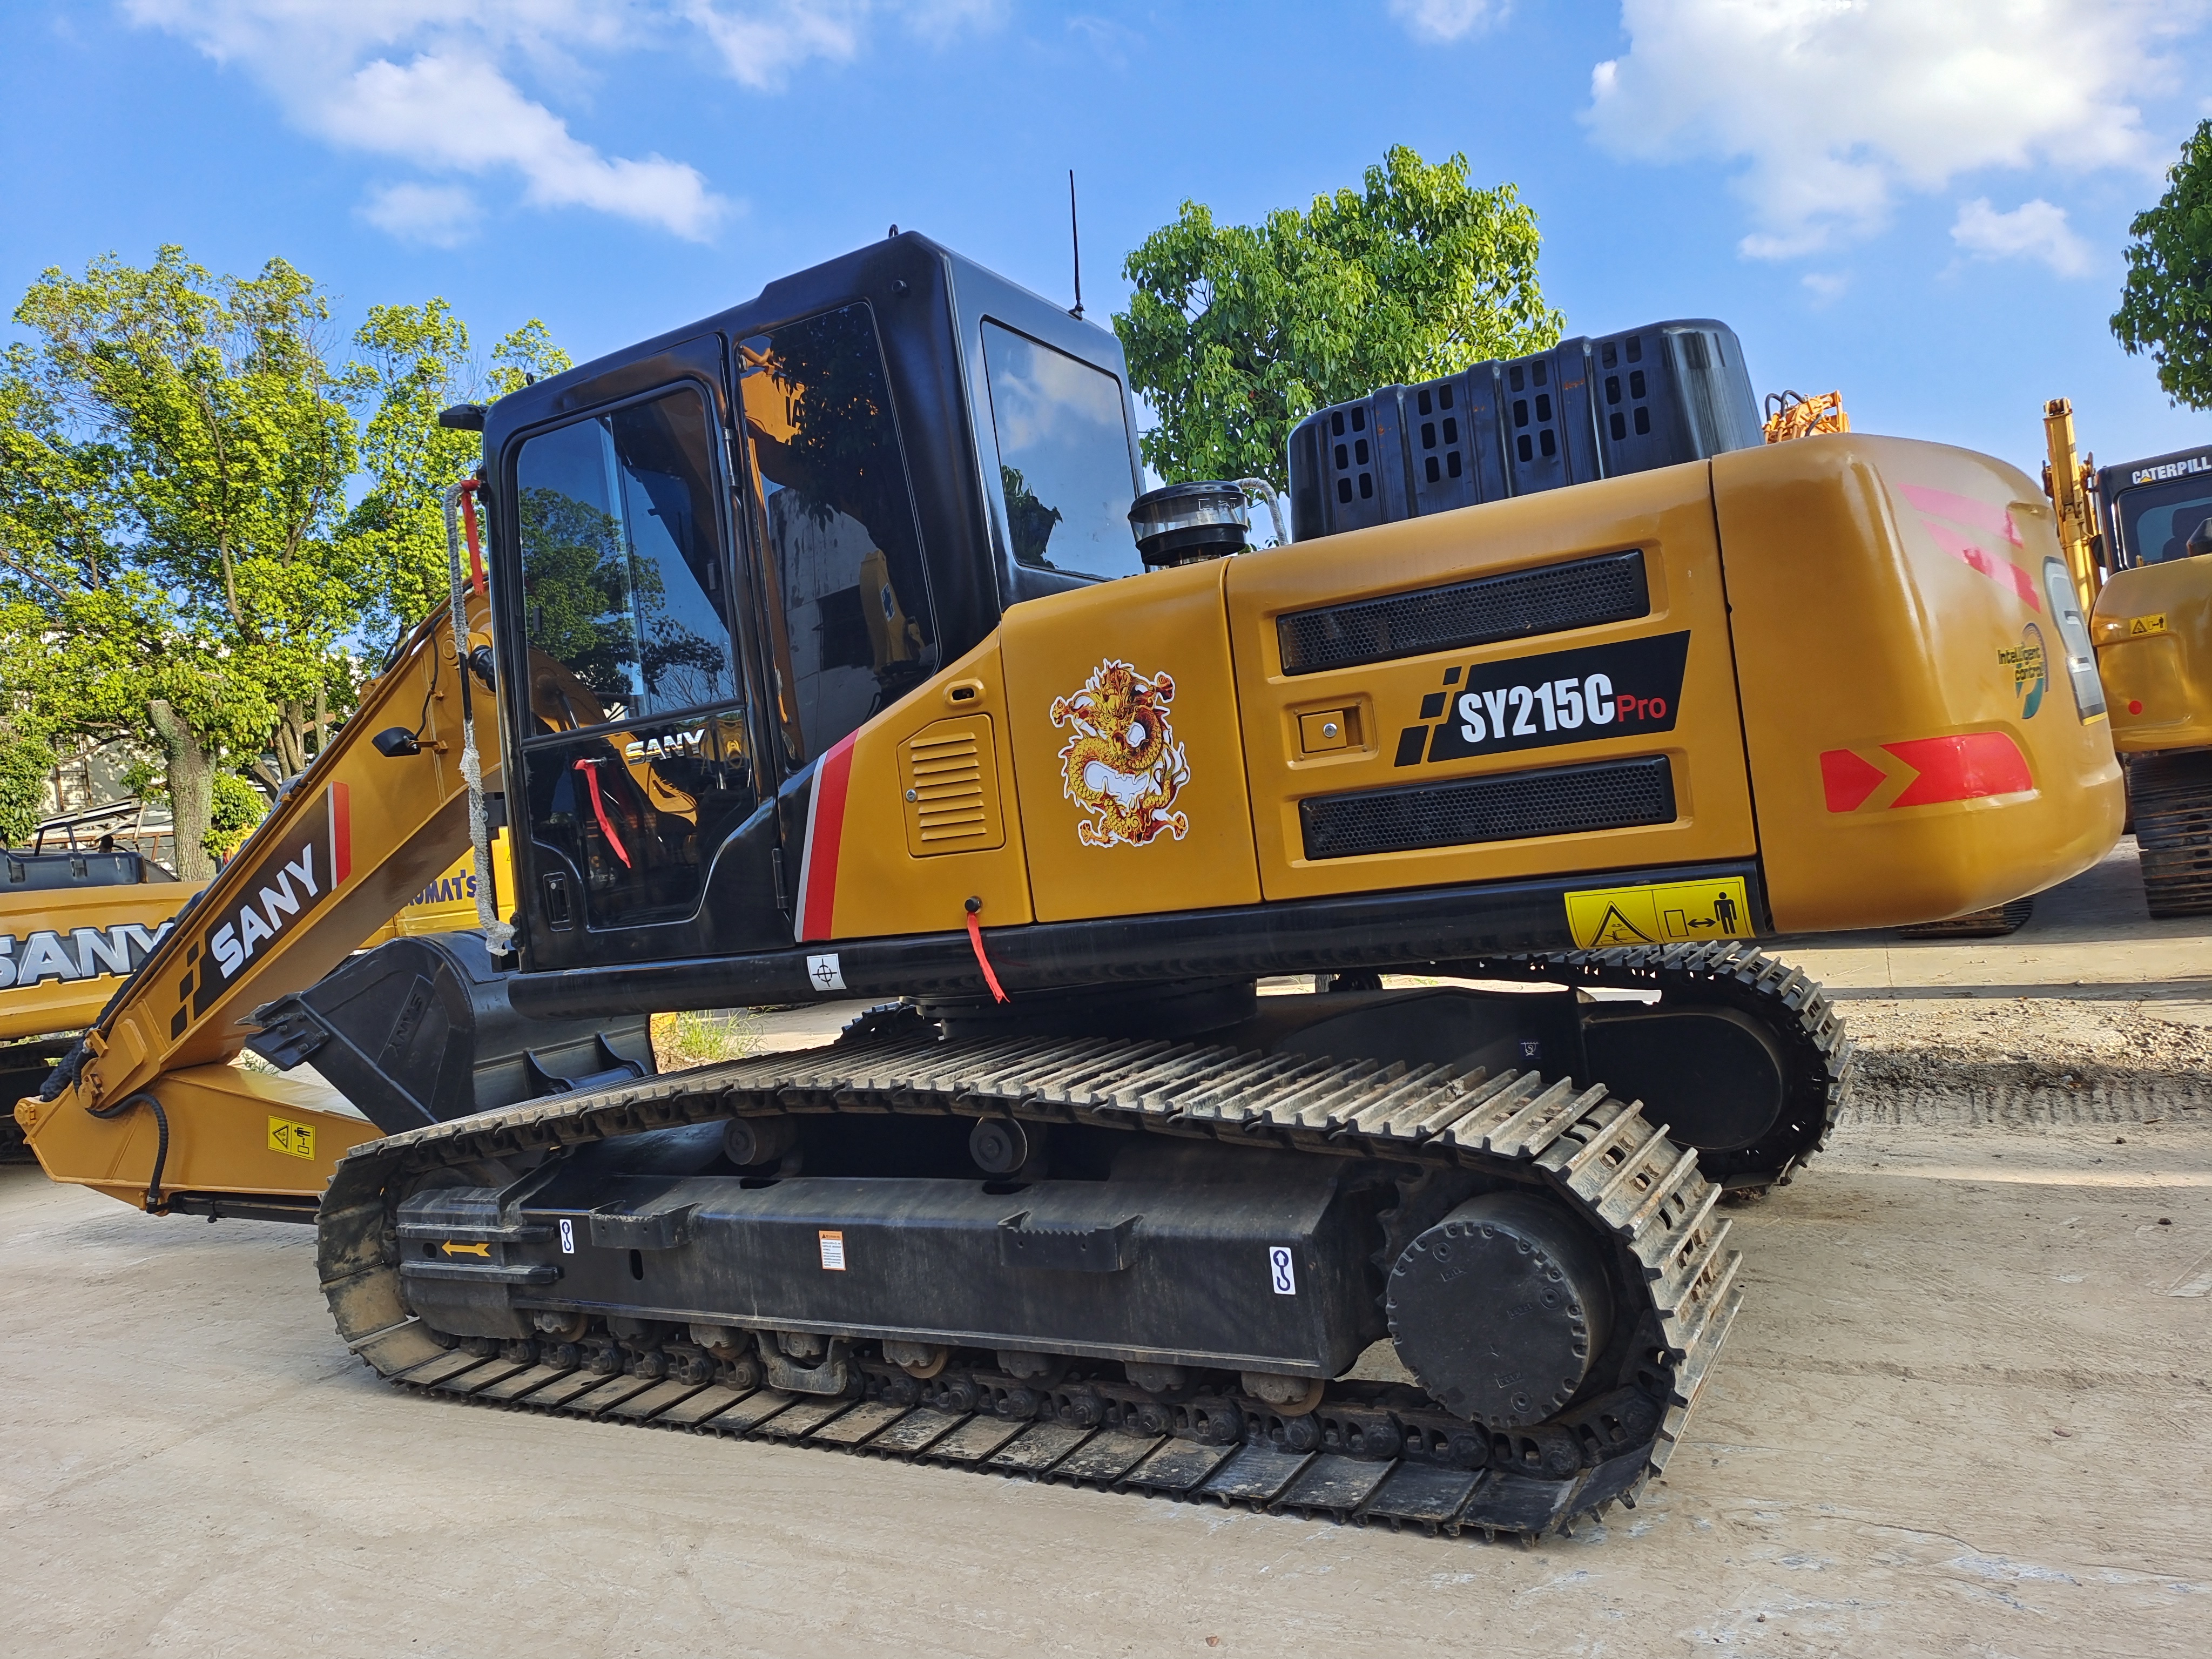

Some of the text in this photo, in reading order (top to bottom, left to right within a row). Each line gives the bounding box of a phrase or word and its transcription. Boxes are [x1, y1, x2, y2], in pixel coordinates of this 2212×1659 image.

[2132, 456, 2212, 484] CATERPILL
[625, 729, 705, 766] SANY
[211, 842, 319, 979] SANY
[1509, 1303, 1534, 1317] LEVEL
